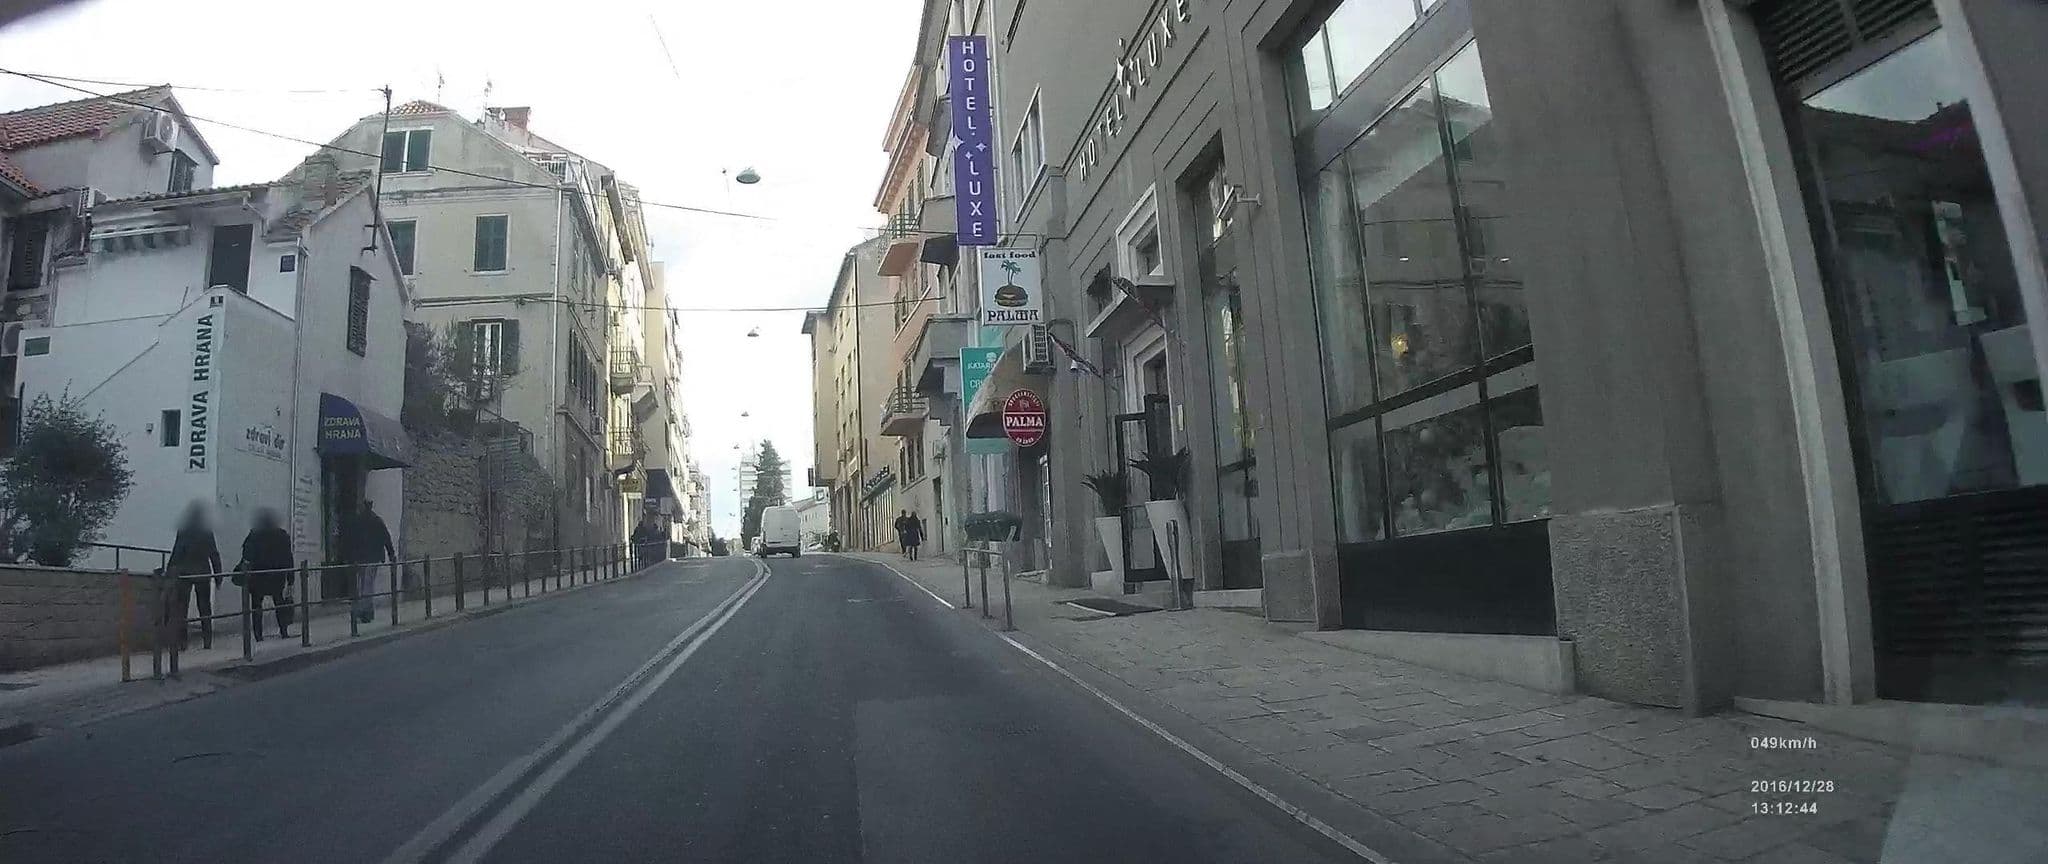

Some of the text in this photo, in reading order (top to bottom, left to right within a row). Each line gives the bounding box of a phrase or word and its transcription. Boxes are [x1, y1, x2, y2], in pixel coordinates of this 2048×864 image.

[1079, 0, 1186, 182] HOTEL LUXE
[962, 41, 983, 237] HOTEL LUXE
[190, 314, 213, 469] ZDRAVA HRANA
[324, 416, 360, 427] ZDRAVA
[1006, 416, 1043, 427] PALMA
[325, 429, 361, 440] HRANA
